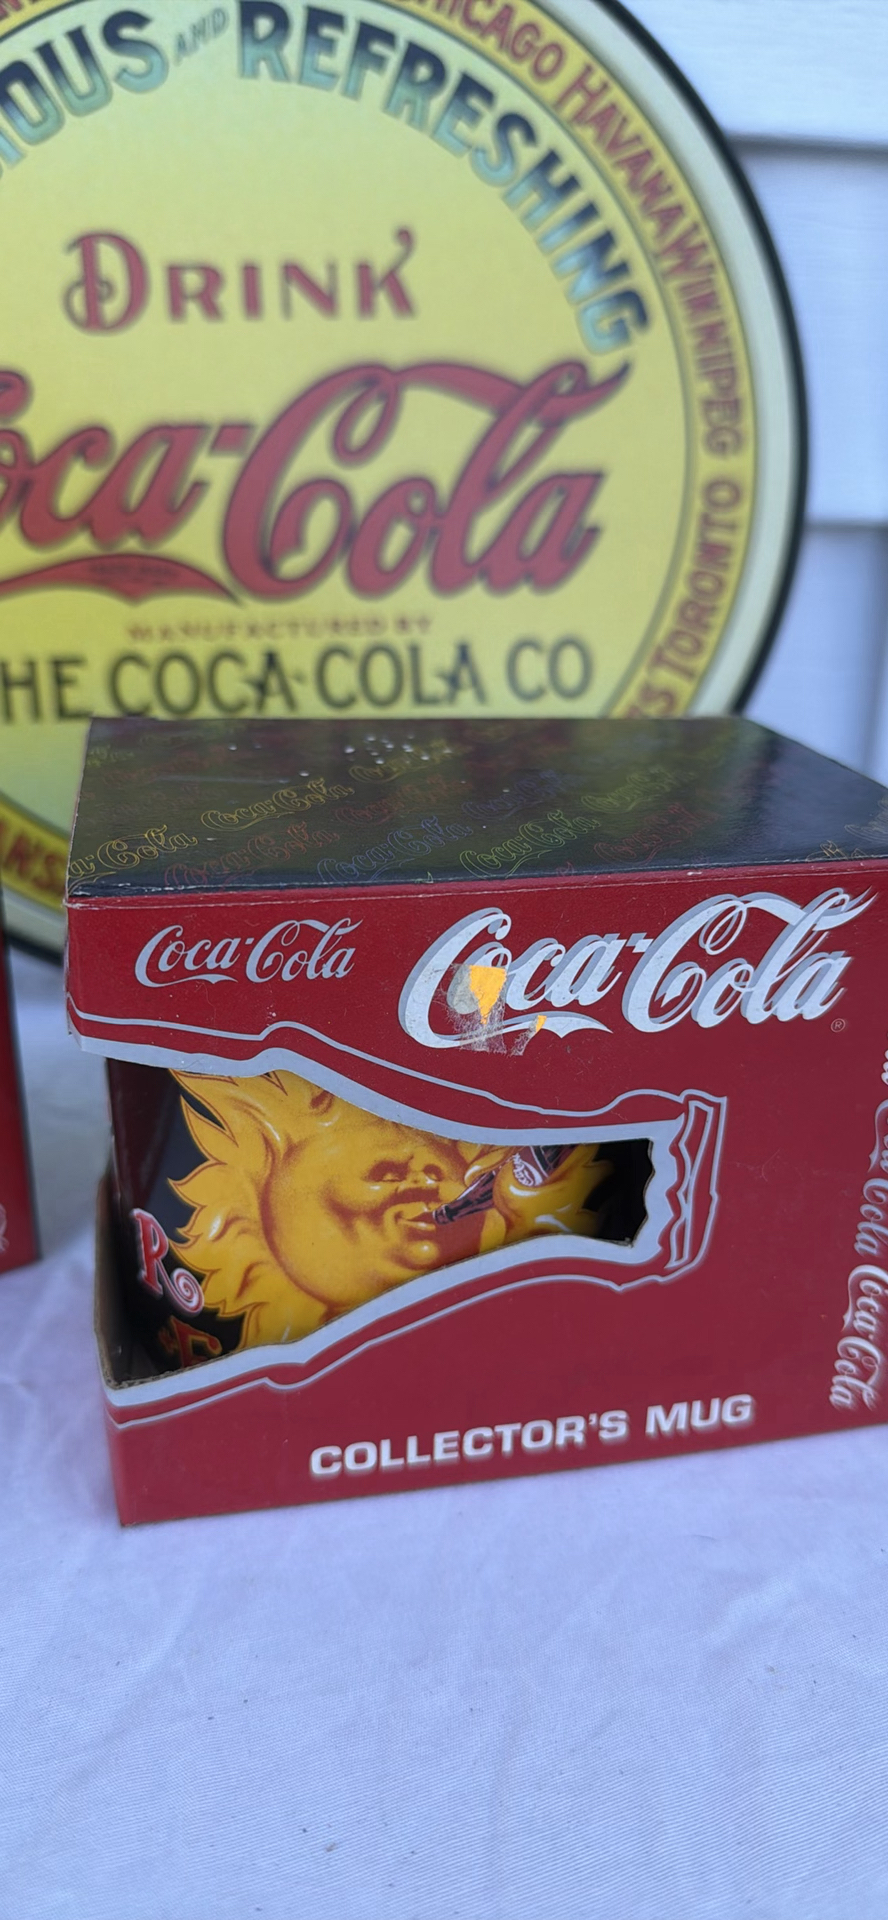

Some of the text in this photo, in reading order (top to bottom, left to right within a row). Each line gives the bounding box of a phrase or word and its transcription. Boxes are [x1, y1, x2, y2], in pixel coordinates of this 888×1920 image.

[0, 1, 650, 354] OUS AND REFRESHING
[553, 63, 685, 240] HAVANA
[663, 221, 743, 458] WINNIPEG
[652, 478, 741, 681] TORONTO
[0, 658, 88, 726] HE
[505, 634, 594, 702] CO
[201, 778, 355, 832] Coca-Cola
[460, 809, 601, 879] Coca-Cola
[134, 908, 363, 988] Coca-Cola
[398, 886, 878, 1050] Coca-Cola
[310, 1393, 755, 1476] COLLECTOR'S MUG
